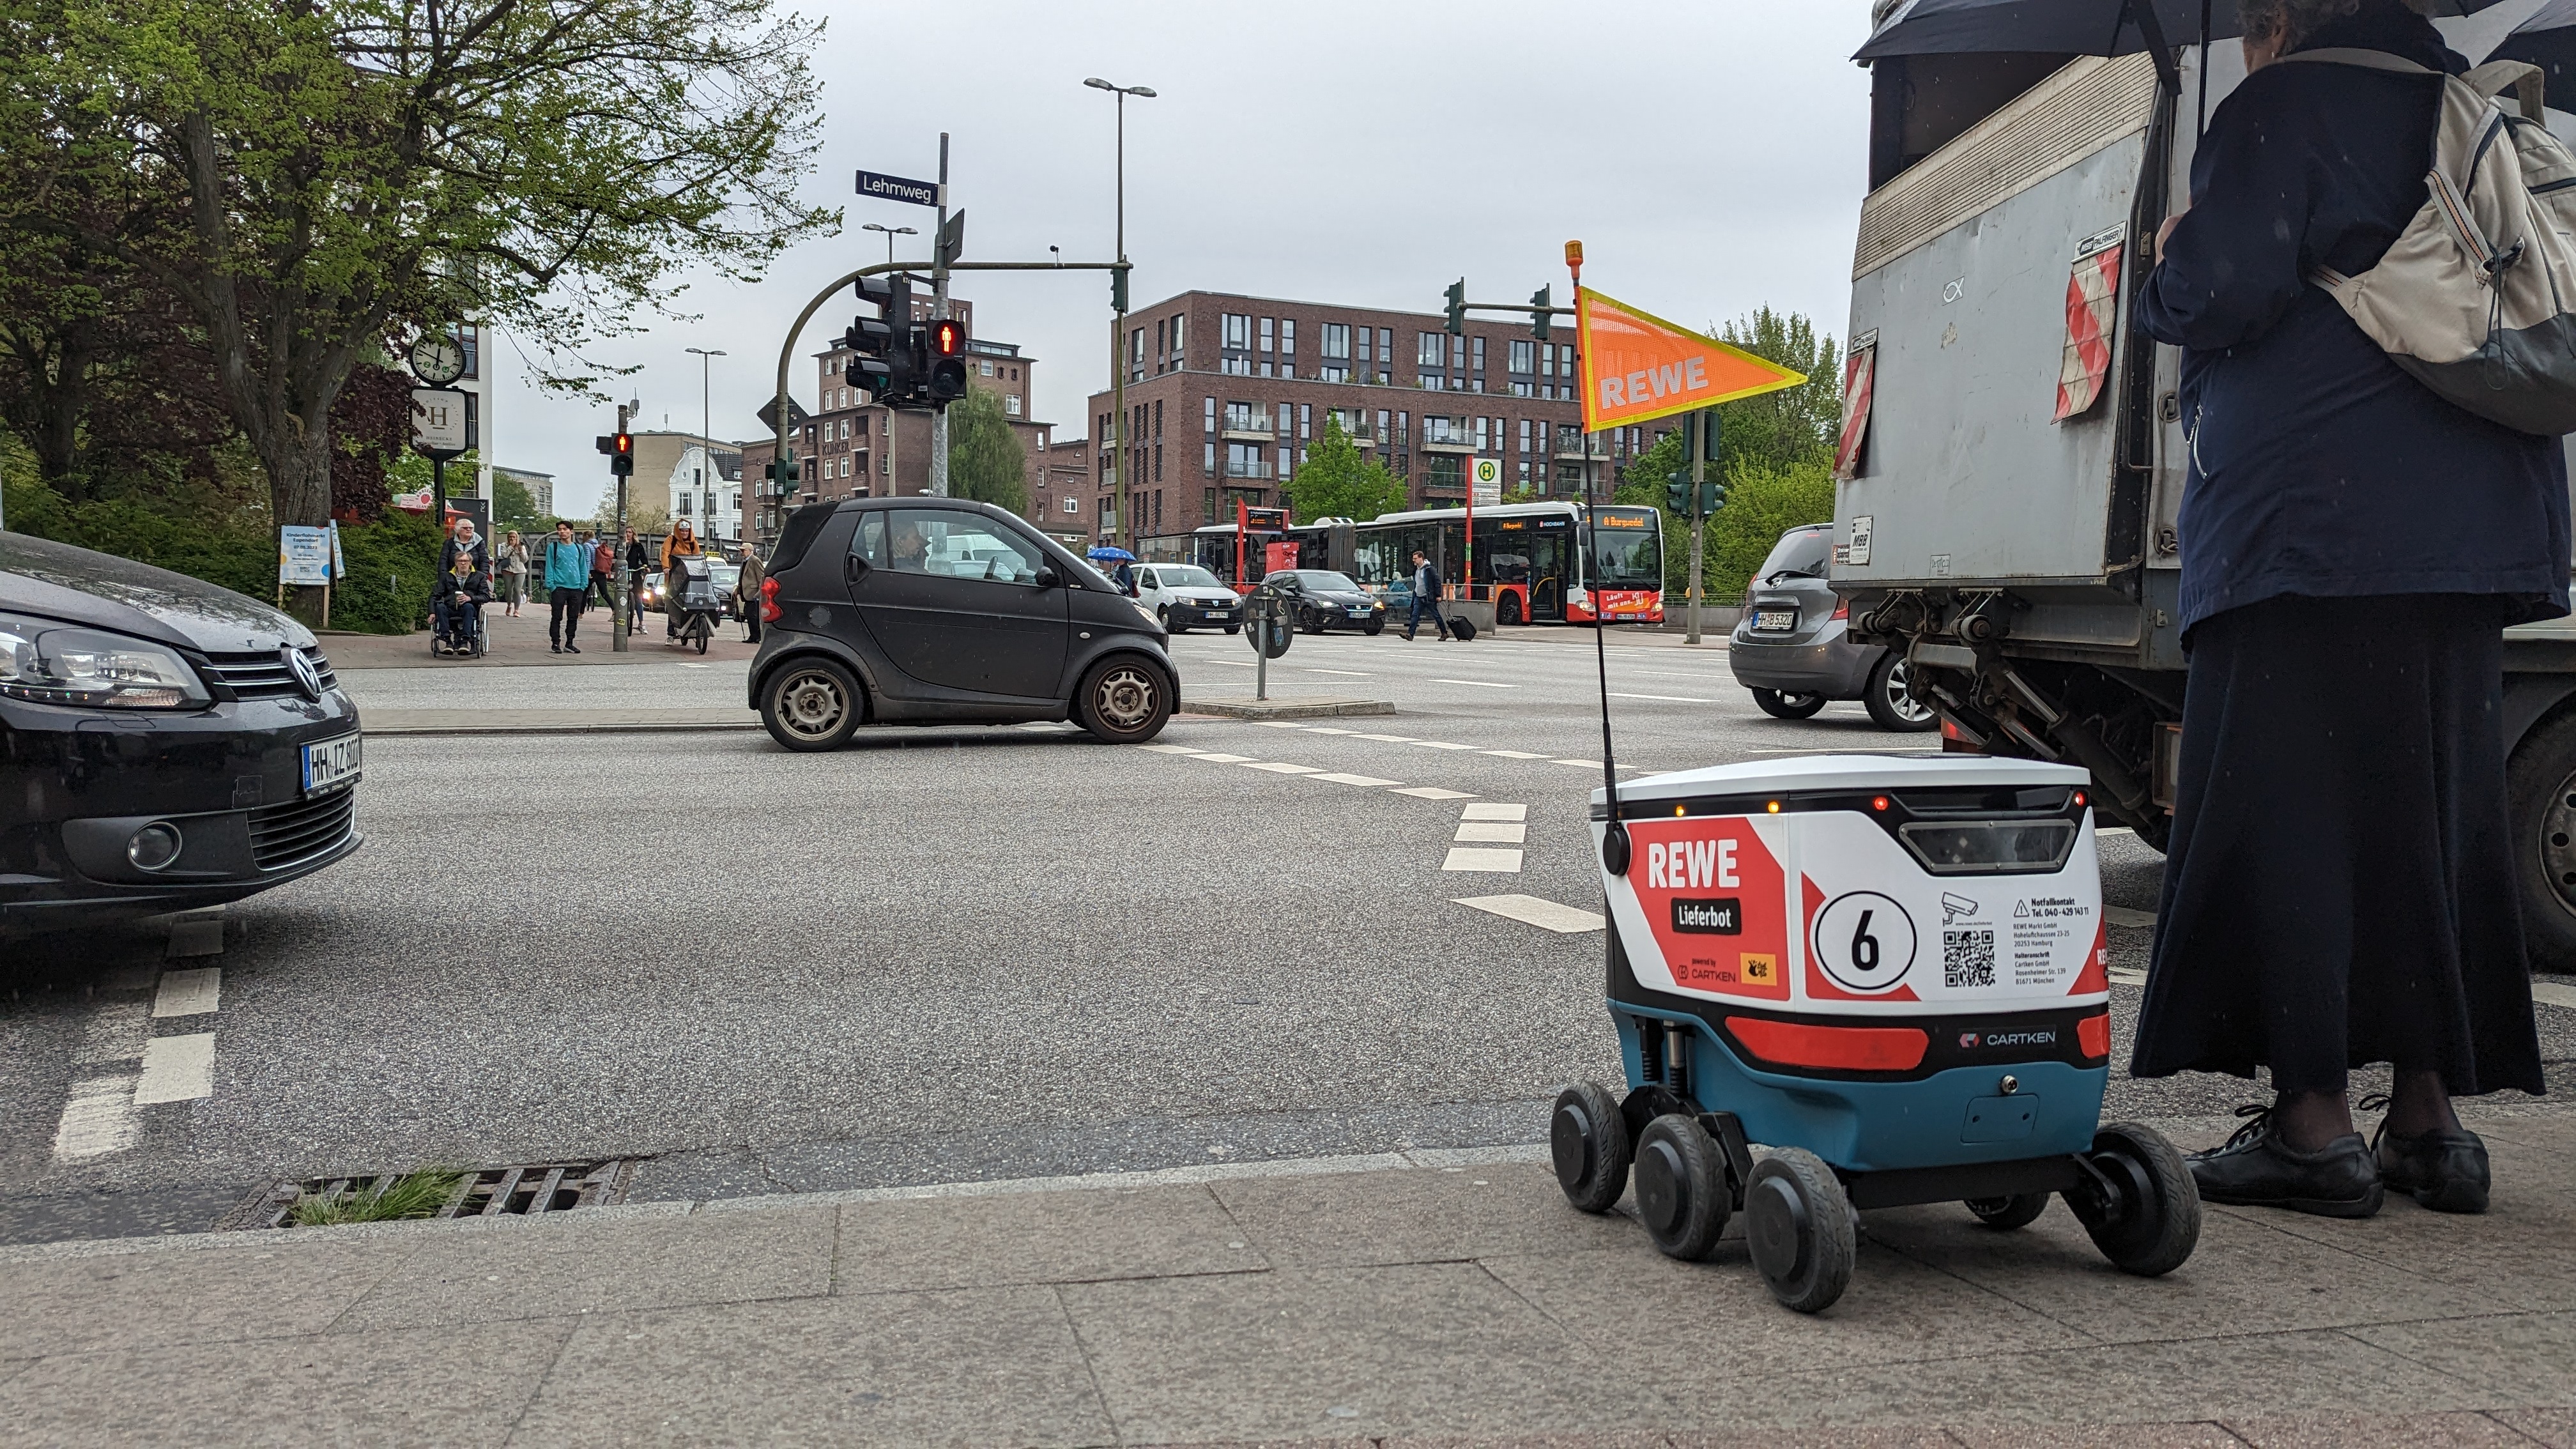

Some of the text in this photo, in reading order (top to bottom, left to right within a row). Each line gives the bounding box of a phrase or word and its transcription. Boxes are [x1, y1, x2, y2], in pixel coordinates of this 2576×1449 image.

[864, 174, 931, 204] Lehmweg
[2093, 230, 2119, 247] PALFINGER
[1600, 355, 1708, 409] REWE
[429, 406, 448, 426] H
[1482, 466, 1491, 477] H
[1604, 516, 1644, 527] A Burgwedel
[1852, 533, 1868, 547] MBB
[1606, 593, 1623, 601] Läuft
[1757, 614, 1793, 625] HH B 5320
[311, 746, 328, 783] HH
[334, 742, 345, 776] IZ
[1648, 839, 1740, 888] REWE
[2031, 897, 2076, 907] Notfallkontakt
[1678, 905, 1732, 928] Lieferbot
[2032, 908, 2043, 917] Tel.
[2044, 908, 2058, 917] 040
[2062, 907, 2073, 916] 429
[2074, 907, 2083, 916] 143
[2084, 907, 2089, 915] 11
[1852, 910, 1879, 971] 6
[2014, 951, 2050, 959] Halteranschrift
[1710, 959, 1716, 967] by
[1692, 969, 1736, 983] CARTKEN
[1987, 1031, 2055, 1046] CARTKEN
